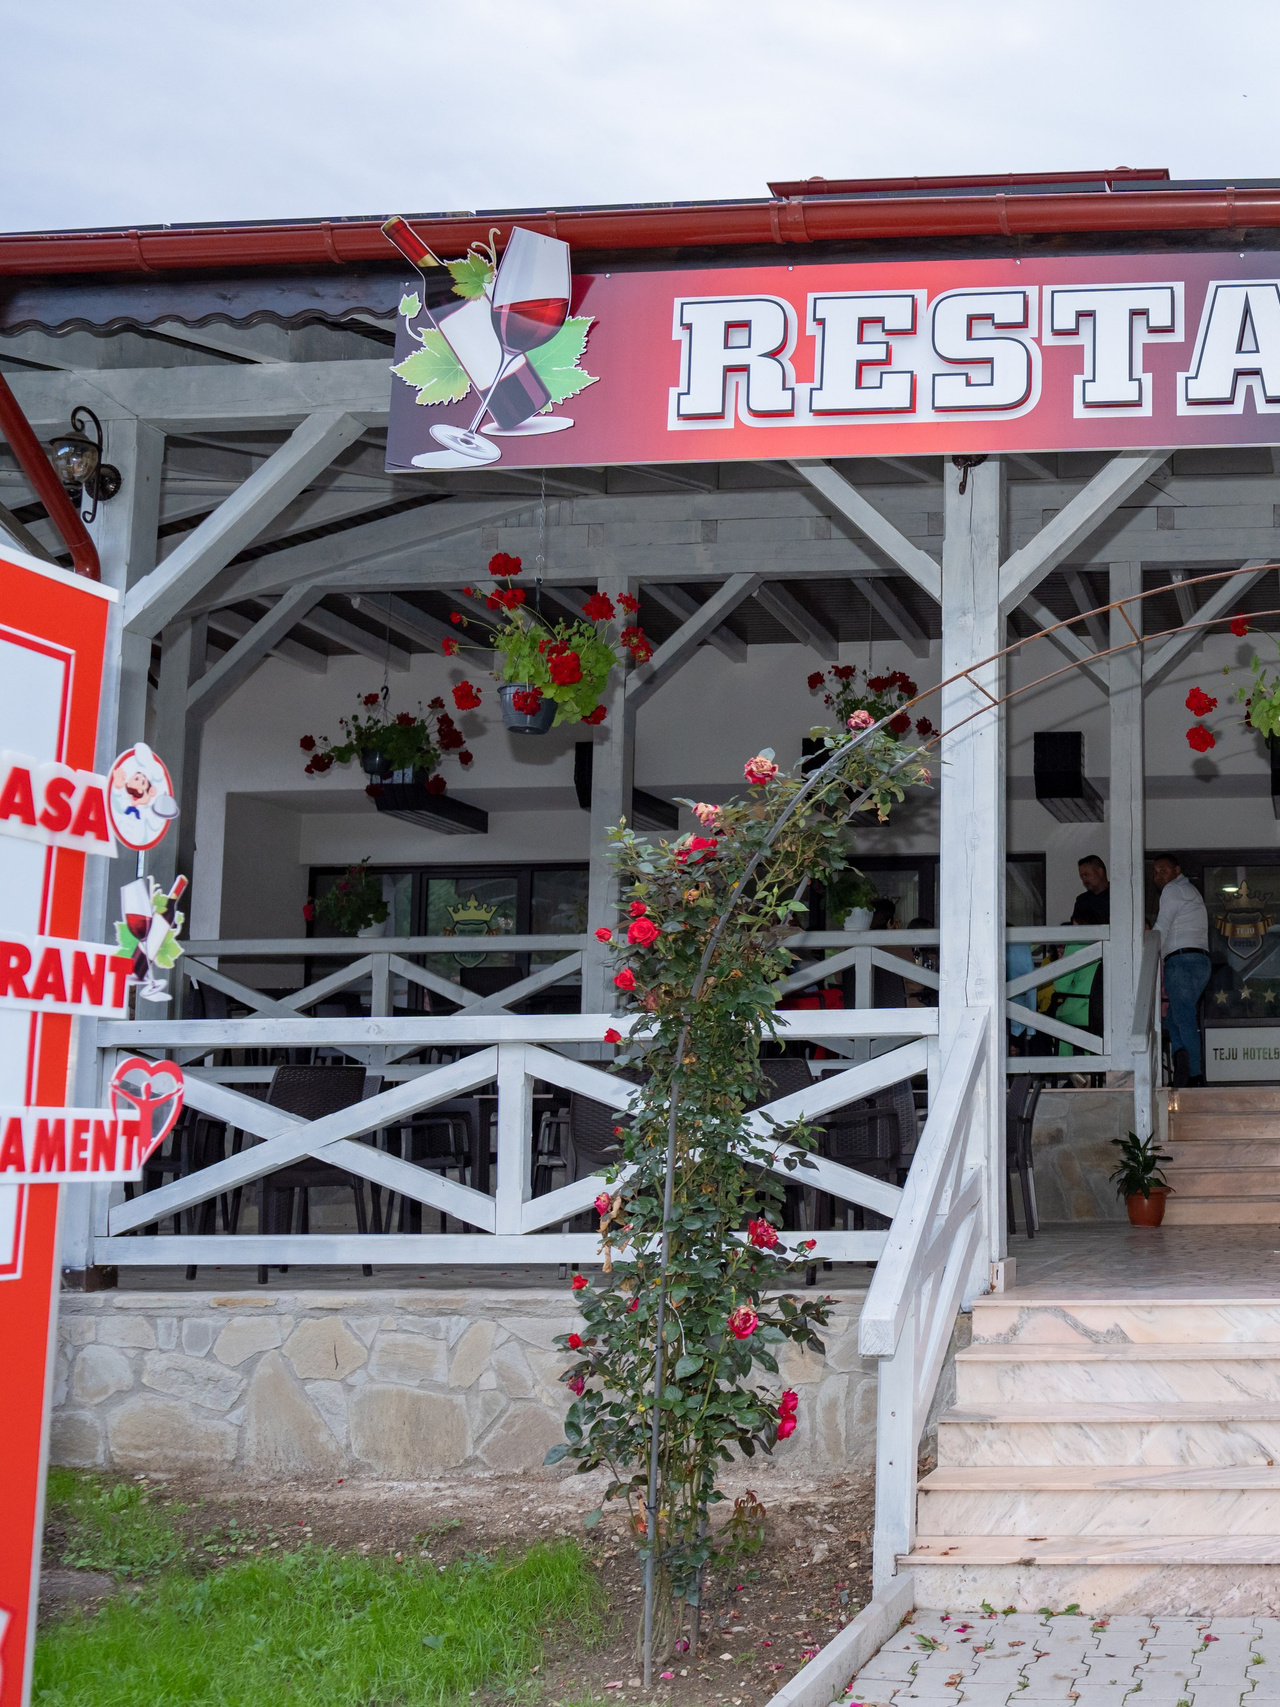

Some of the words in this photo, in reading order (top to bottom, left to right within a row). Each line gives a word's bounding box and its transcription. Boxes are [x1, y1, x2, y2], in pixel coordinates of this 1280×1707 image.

[0, 766, 110, 842] ASA
[1235, 927, 1255, 935] TEJU
[0, 940, 135, 1008] RANT
[1213, 1048, 1238, 1061] TEJU
[1242, 1047, 1280, 1060] HOTELS
[0, 1117, 141, 1173] AMENT
